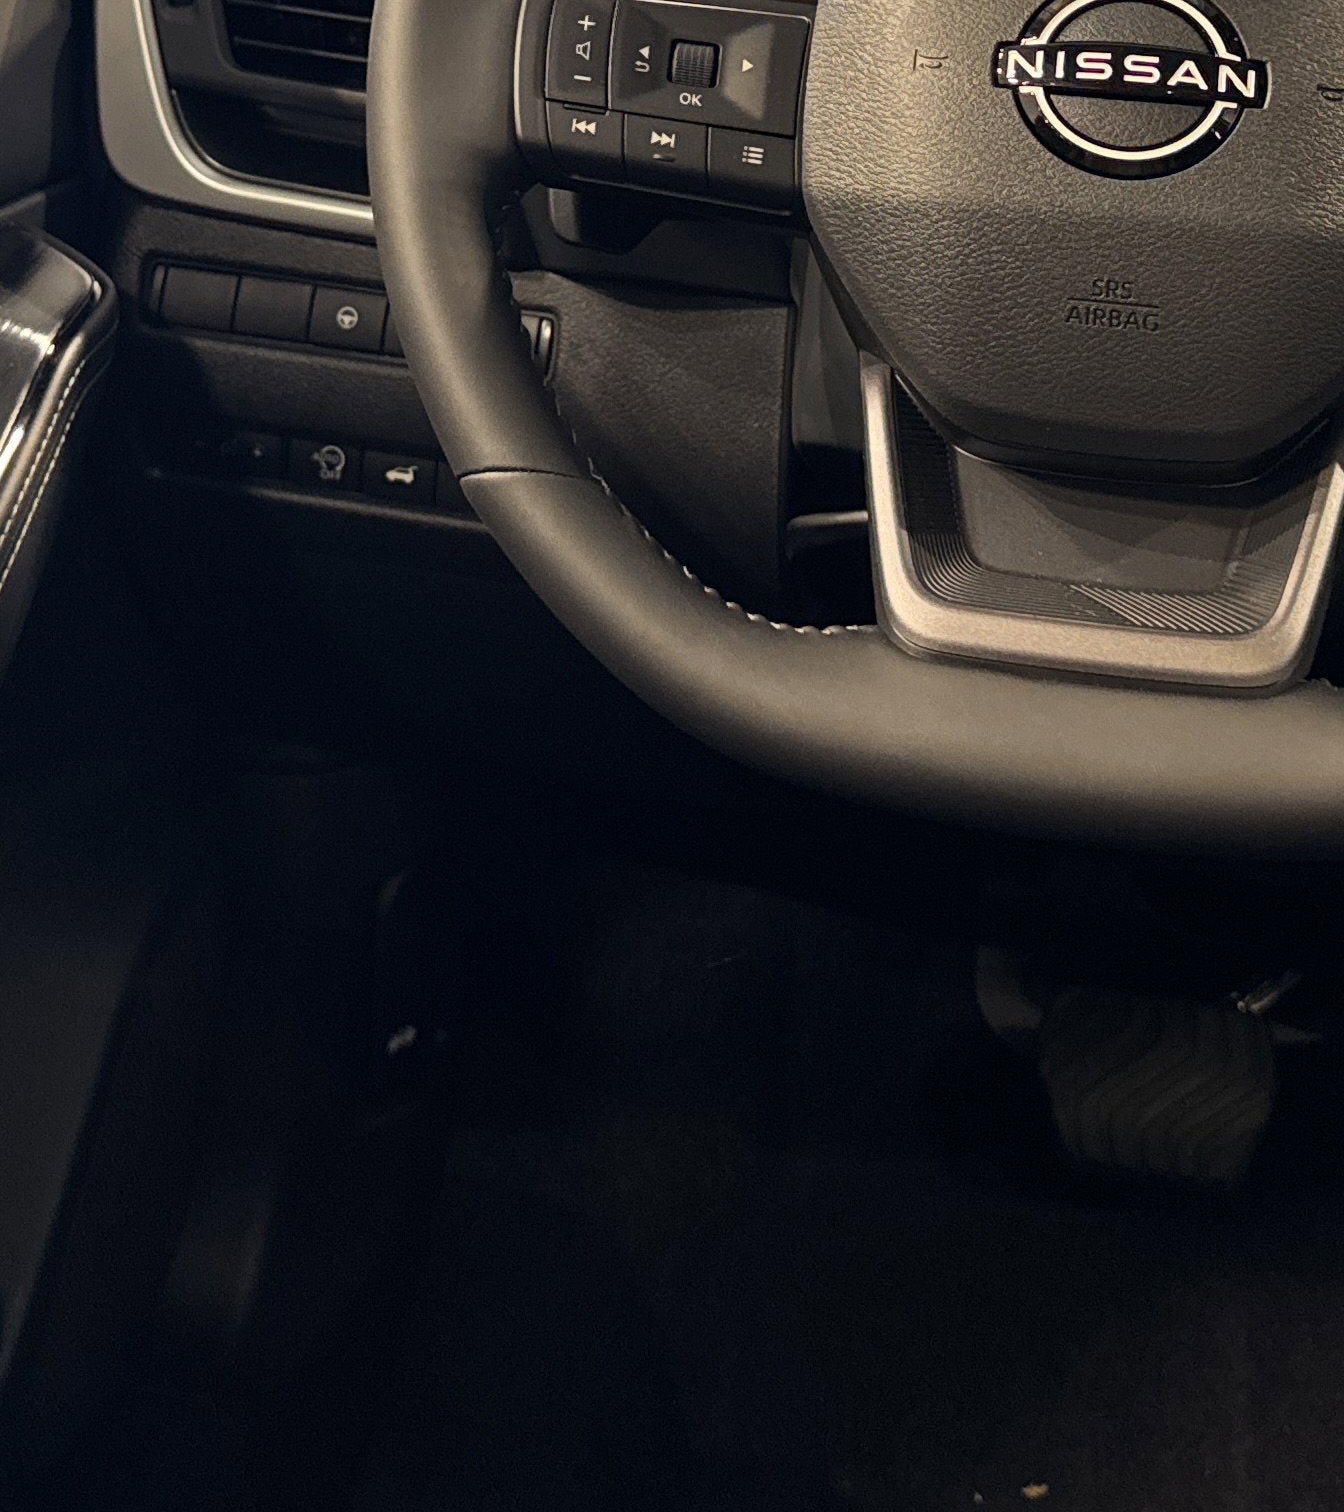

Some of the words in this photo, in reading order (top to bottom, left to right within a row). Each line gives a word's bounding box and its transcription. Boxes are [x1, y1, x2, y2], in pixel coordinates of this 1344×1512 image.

[1006, 50, 1256, 98] NISSAN
[679, 92, 703, 107] OK
[1090, 278, 1133, 301] SRS
[1065, 307, 1160, 333] AIRBAG
